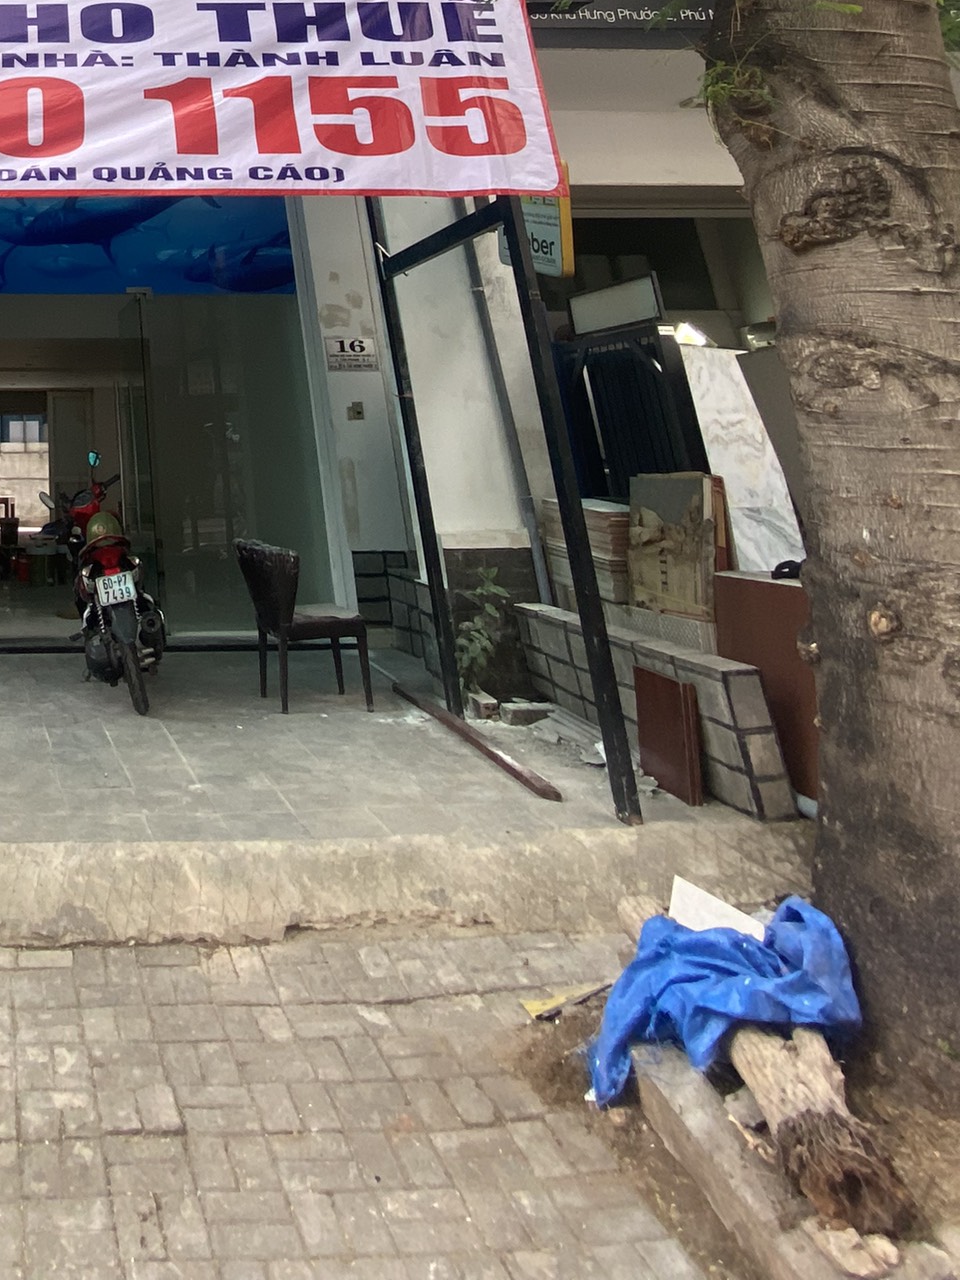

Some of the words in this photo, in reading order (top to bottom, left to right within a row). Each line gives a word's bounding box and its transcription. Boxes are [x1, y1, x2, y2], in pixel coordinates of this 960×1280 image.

[579, 8, 616, 22] Hưng
[680, 7, 703, 20] Phú
[2, 49, 134, 68] NHÀ:
[153, 48, 339, 68] THÀNH
[360, 48, 505, 67] LUÂN
[143, 74, 527, 158] 1155
[92, 162, 234, 183] QUẢNG
[248, 162, 345, 183] CÁO)
[335, 339, 366, 353] 16
[102, 574, 128, 591] 60-P7
[104, 586, 132, 603] 7439
